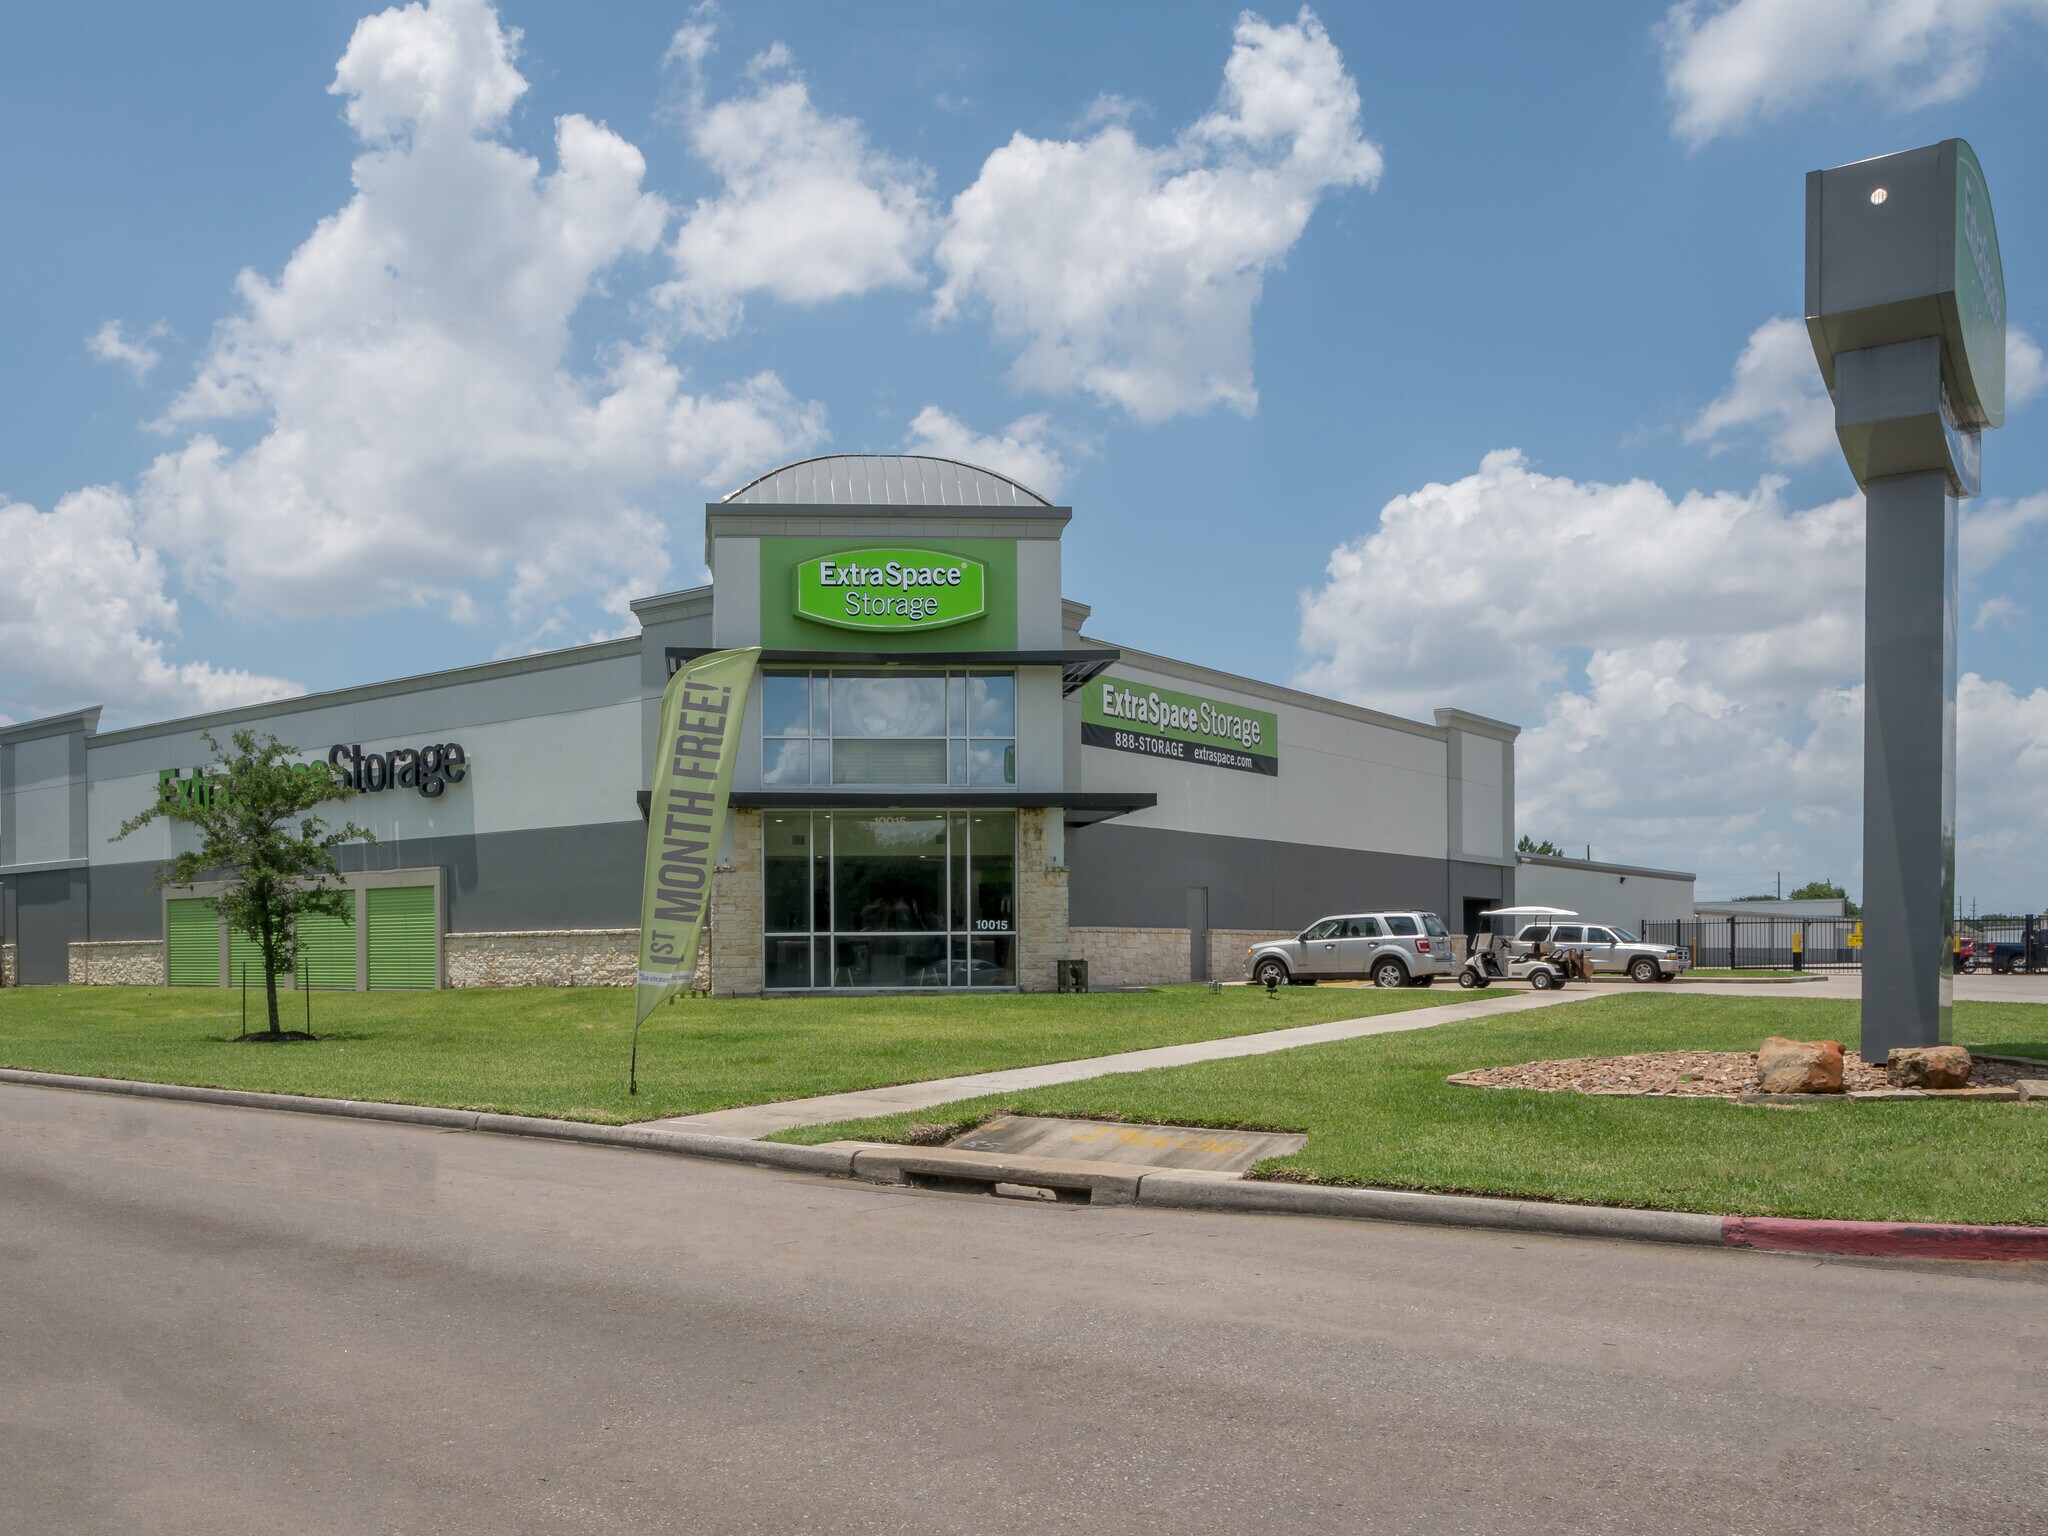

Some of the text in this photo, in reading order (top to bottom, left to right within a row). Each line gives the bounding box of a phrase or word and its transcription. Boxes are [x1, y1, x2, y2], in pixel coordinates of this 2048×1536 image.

[845, 591, 939, 621] Storage
[1200, 702, 1262, 749] Storage
[328, 742, 466, 798] Storage
[1115, 732, 1253, 769] 888-STORAGE extraspace.com
[654, 788, 716, 923] MONTH
[975, 919, 1008, 930] 10015
